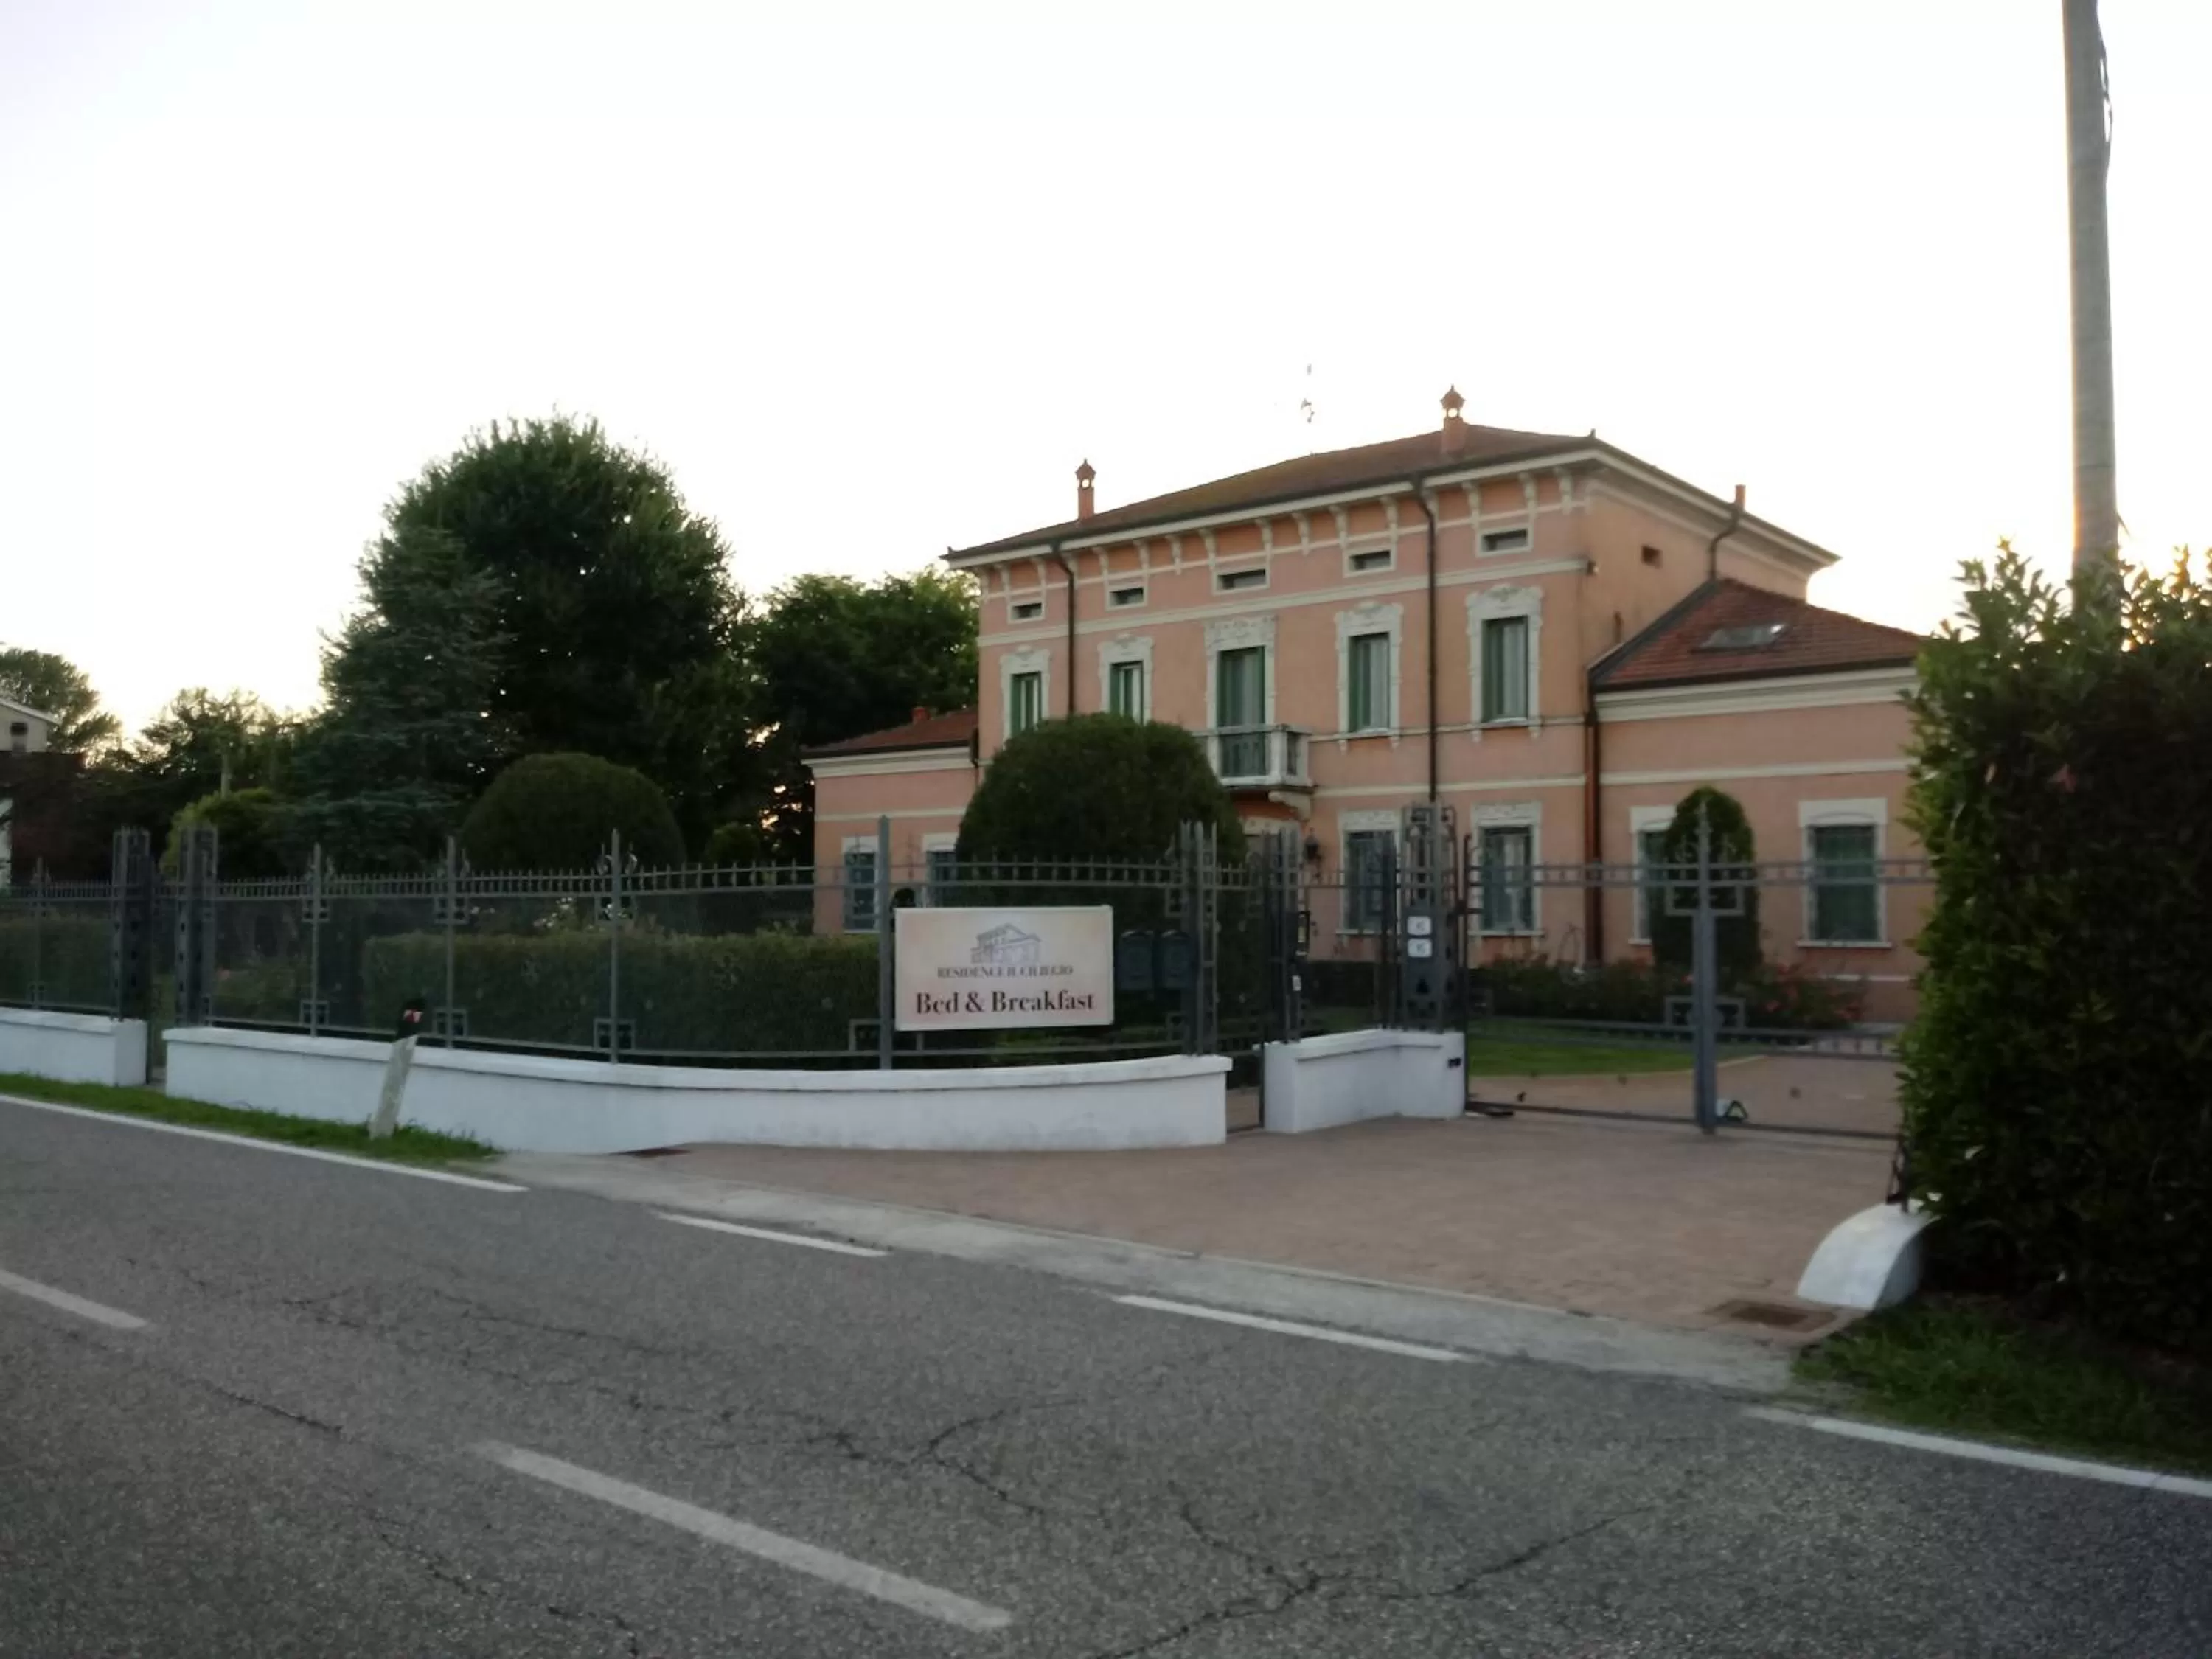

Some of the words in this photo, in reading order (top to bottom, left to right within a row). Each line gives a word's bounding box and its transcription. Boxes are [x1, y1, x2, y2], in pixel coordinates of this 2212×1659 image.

[915, 992, 958, 1015] Bed
[964, 990, 984, 1013] &
[991, 989, 1096, 1012] Breakfast
